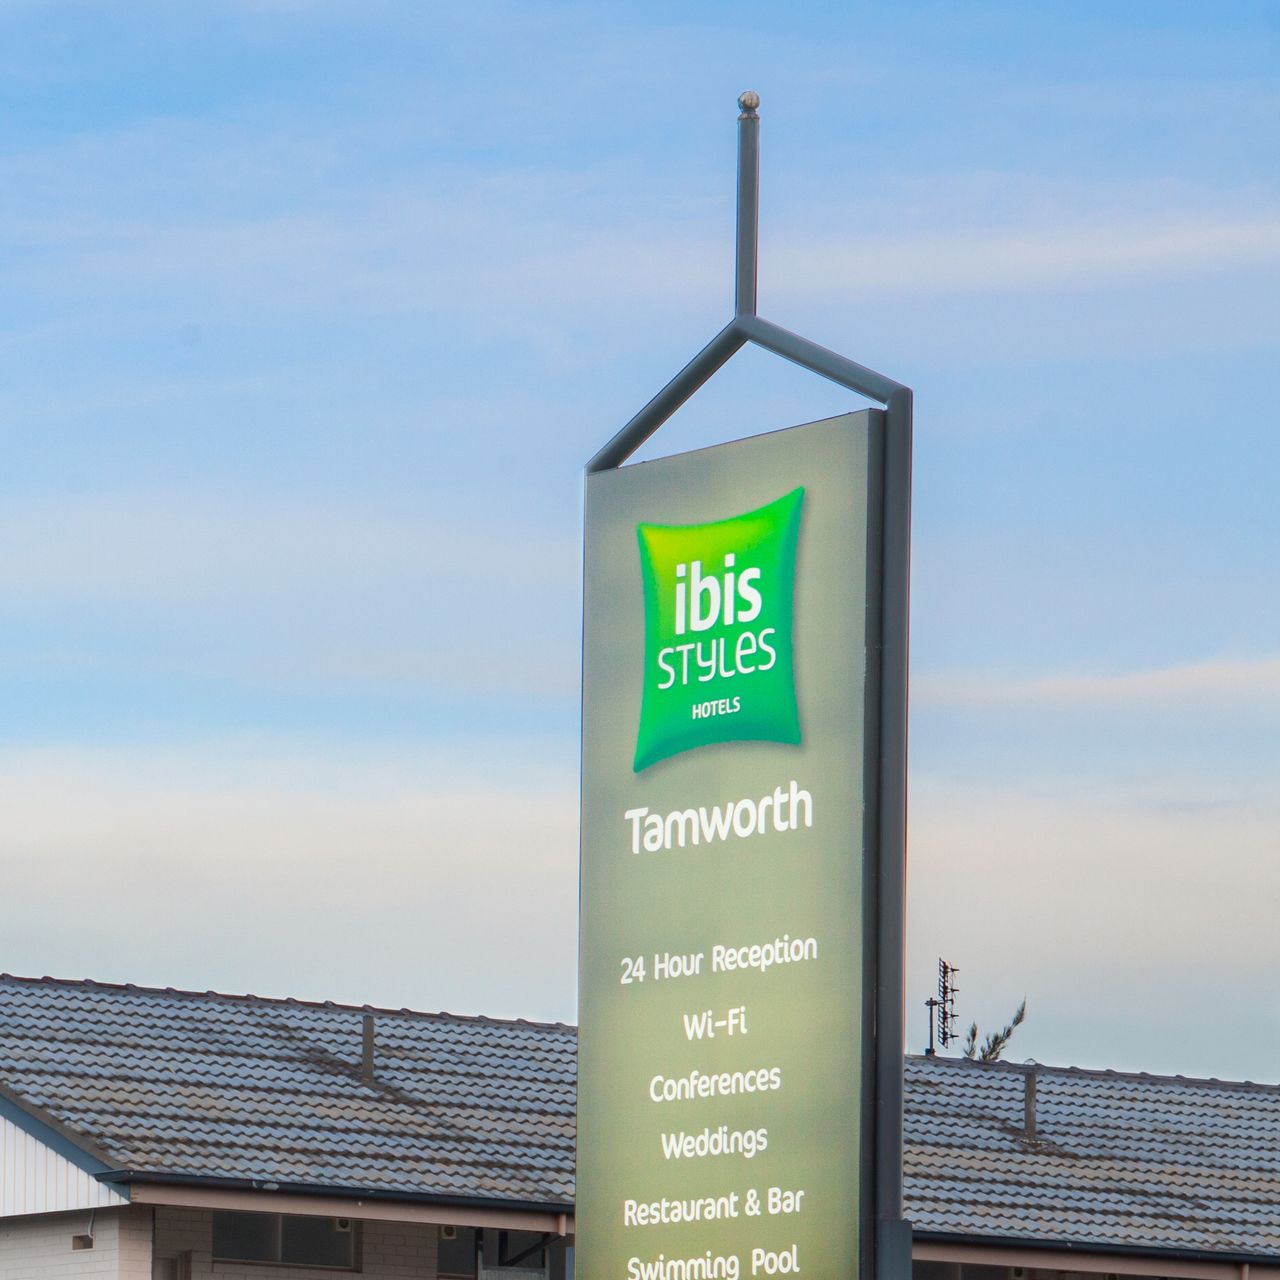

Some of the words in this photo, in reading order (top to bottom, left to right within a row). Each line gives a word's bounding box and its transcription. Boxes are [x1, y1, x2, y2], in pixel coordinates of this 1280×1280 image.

[674, 553, 763, 636] ibis
[691, 696, 741, 720] HOTELS
[624, 780, 813, 855] Tamworth
[620, 955, 646, 985] 24
[653, 951, 704, 980] Hour
[711, 934, 818, 973] Reception
[683, 1006, 748, 1041] Wi-Fi
[649, 1066, 782, 1103] Conferences
[661, 1125, 768, 1160] Weddings
[623, 1191, 739, 1227] Restaurant
[744, 1188, 761, 1217] &
[767, 1186, 805, 1215] Bar
[751, 1244, 801, 1276] Pool
